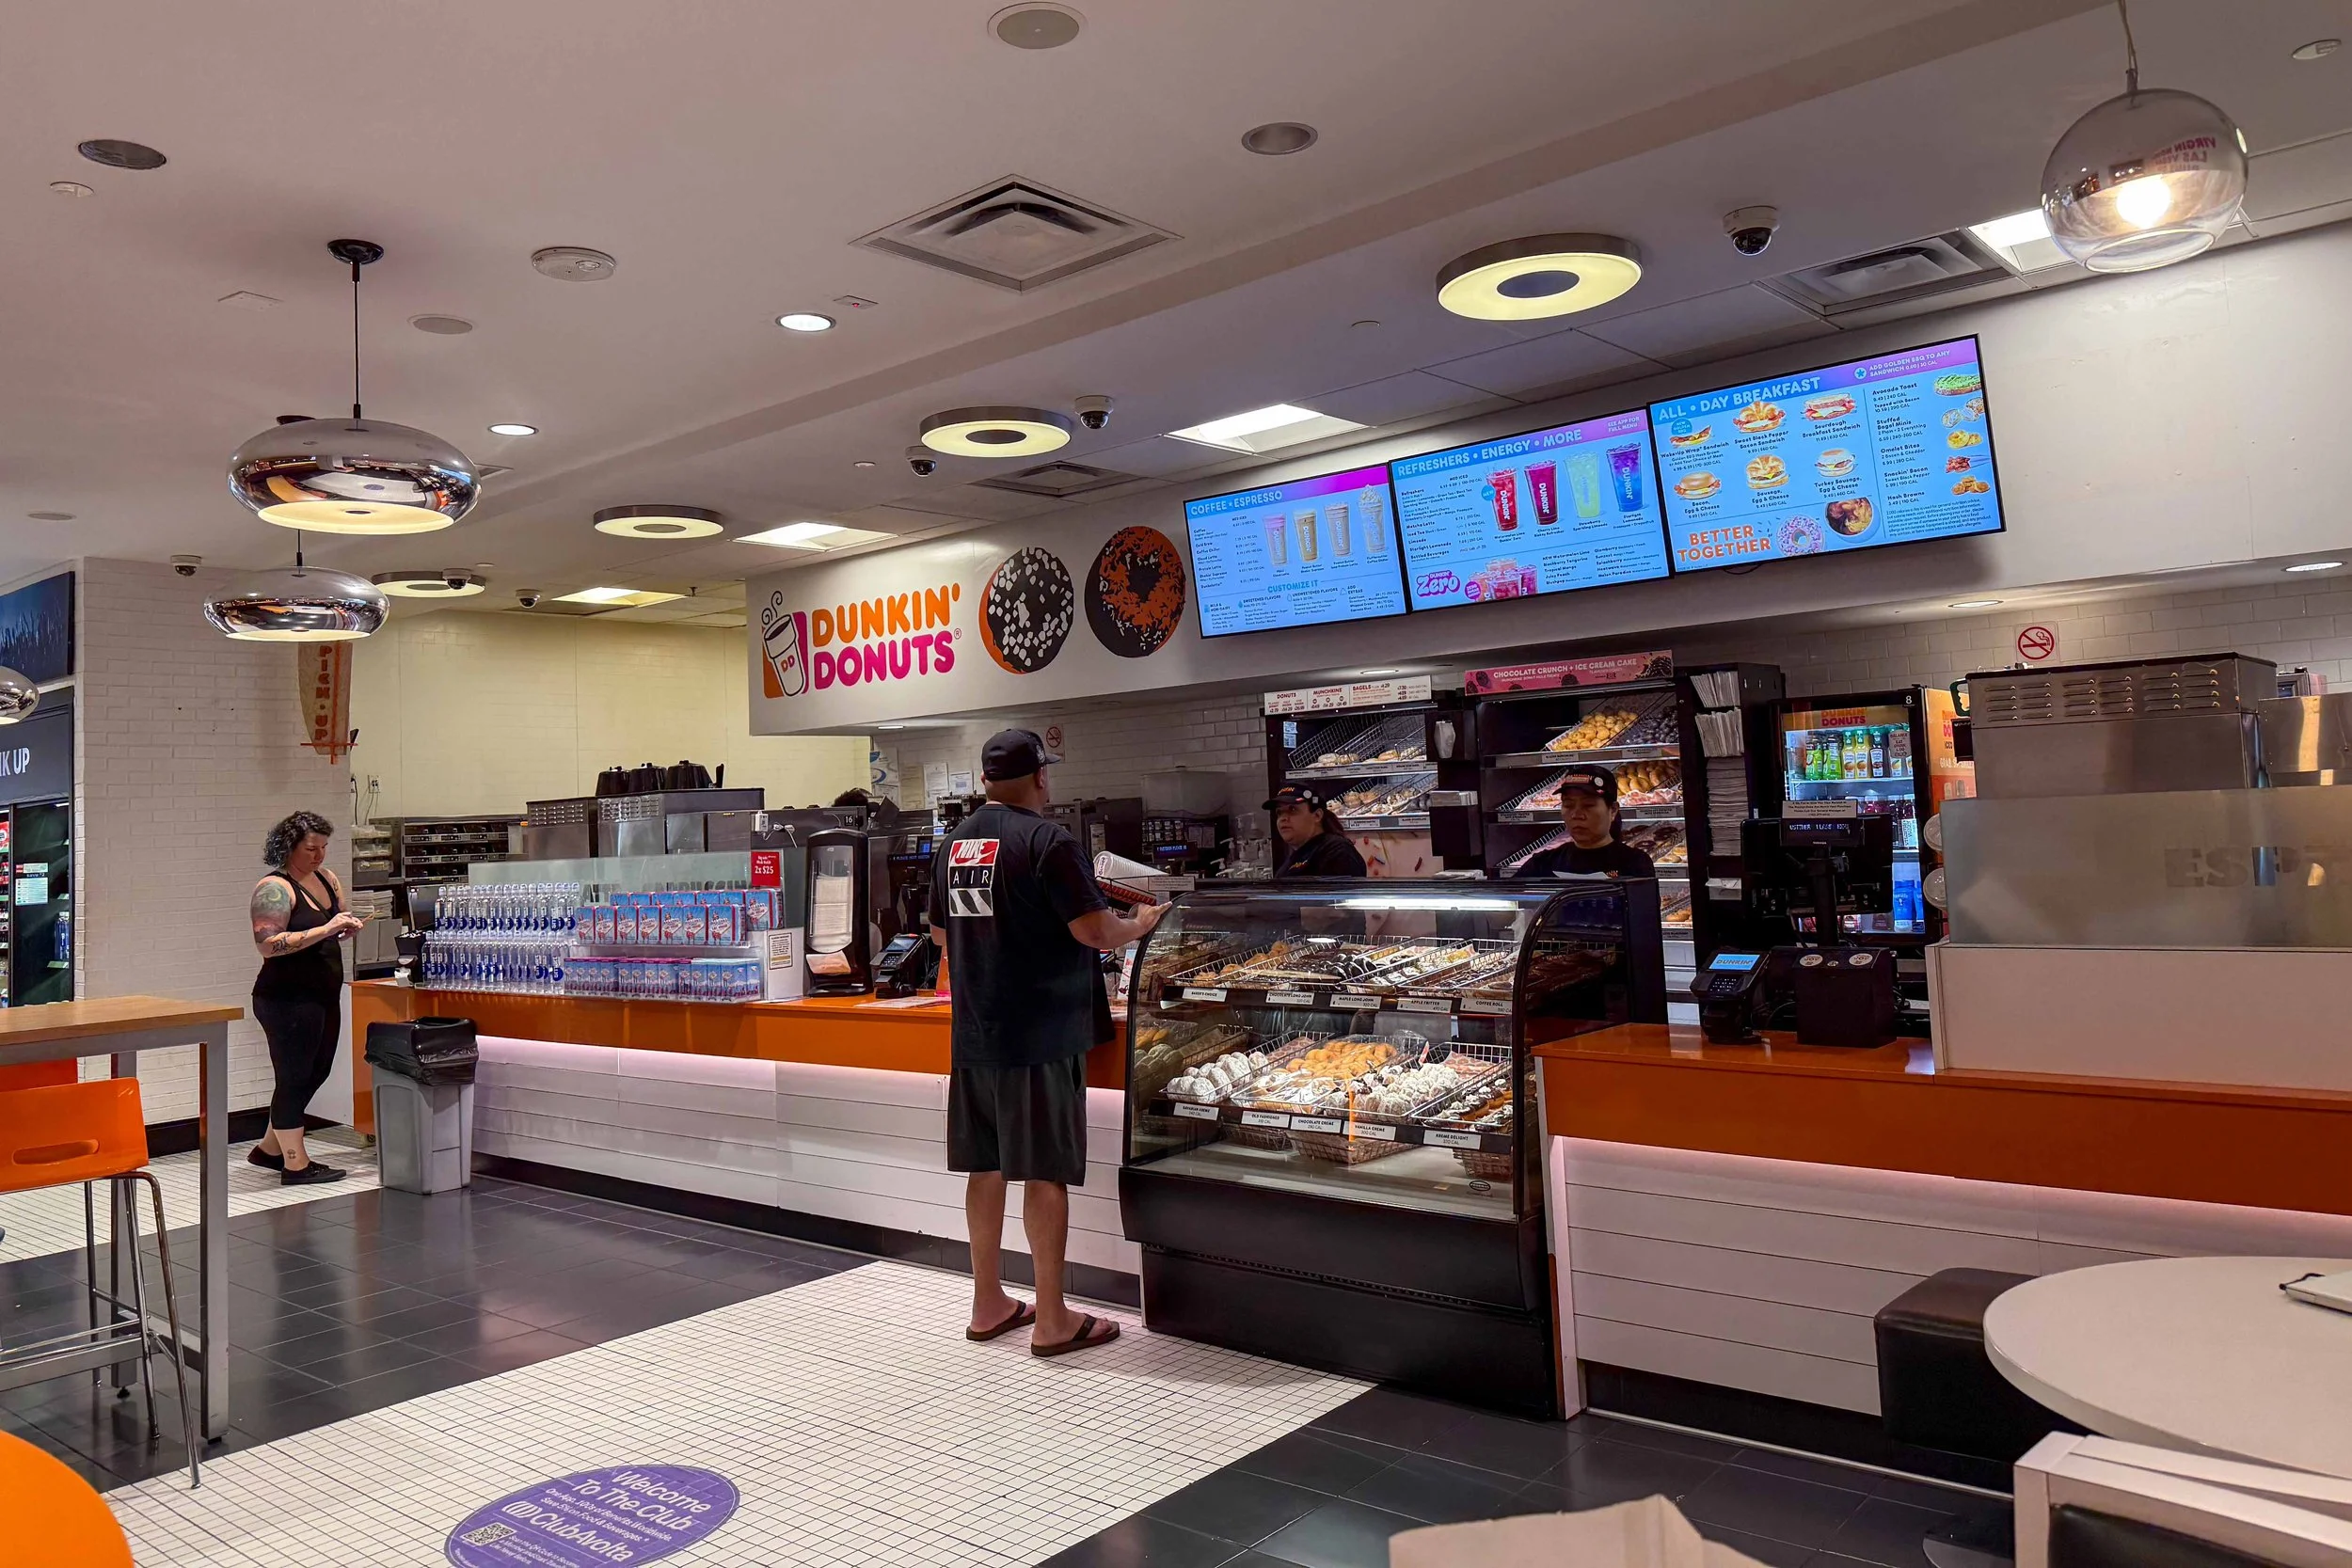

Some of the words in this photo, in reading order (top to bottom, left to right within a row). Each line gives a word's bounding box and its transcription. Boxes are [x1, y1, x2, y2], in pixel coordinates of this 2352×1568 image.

[1883, 359, 1910, 368] GOLDEN
[1870, 367, 1904, 376] SANDWICH
[1659, 405, 1686, 420] ALL
[1700, 396, 1729, 412] DAY
[1733, 376, 1820, 405] BREAKFAST
[1872, 387, 1899, 395] Avocado
[1803, 428, 1831, 437] Breakfast
[1833, 423, 1860, 433] Sandwich
[1814, 420, 1846, 429] Sourdough
[1703, 442, 1729, 451] Sandwich
[1757, 437, 1785, 446] Sandwich
[1397, 452, 1470, 476] REFRESHERS
[1482, 439, 1531, 460] ENERGY
[1543, 429, 1581, 448] MORE
[1622, 467, 1633, 499] DUNKIN'
[1814, 480, 1833, 488] Turkey
[1819, 485, 1831, 494] Egg
[1191, 501, 1227, 515] COFFEE
[1234, 491, 1282, 508] ESPRESSO
[1689, 525, 1754, 546] BETTER
[1677, 538, 1771, 562] TOGETHER
[1267, 581, 1310, 593] CUSTOMIZE
[1417, 575, 1458, 596] Zero
[812, 582, 961, 647] DUNKIN'
[1493, 668, 1536, 679] CHOCOLATE
[1537, 665, 1568, 674] CRUNCH
[1589, 660, 1615, 670] CREAM
[1617, 658, 1637, 667] CAKE
[1905, 695, 1912, 704] 8
[1821, 716, 1866, 726] DONUTS
[13, 748, 30, 774] UP
[956, 841, 988, 859] NIKE
[762, 865, 773, 874] $25
[953, 870, 989, 884] AIR
[612, 1471, 711, 1513] Welcome
[572, 1479, 601, 1496] To
[596, 1487, 641, 1510] The
[636, 1504, 695, 1530] Club
[578, 1513, 596, 1523] Food
[602, 1511, 632, 1526] Benefits
[530, 1513, 634, 1562] ClubAvolta
